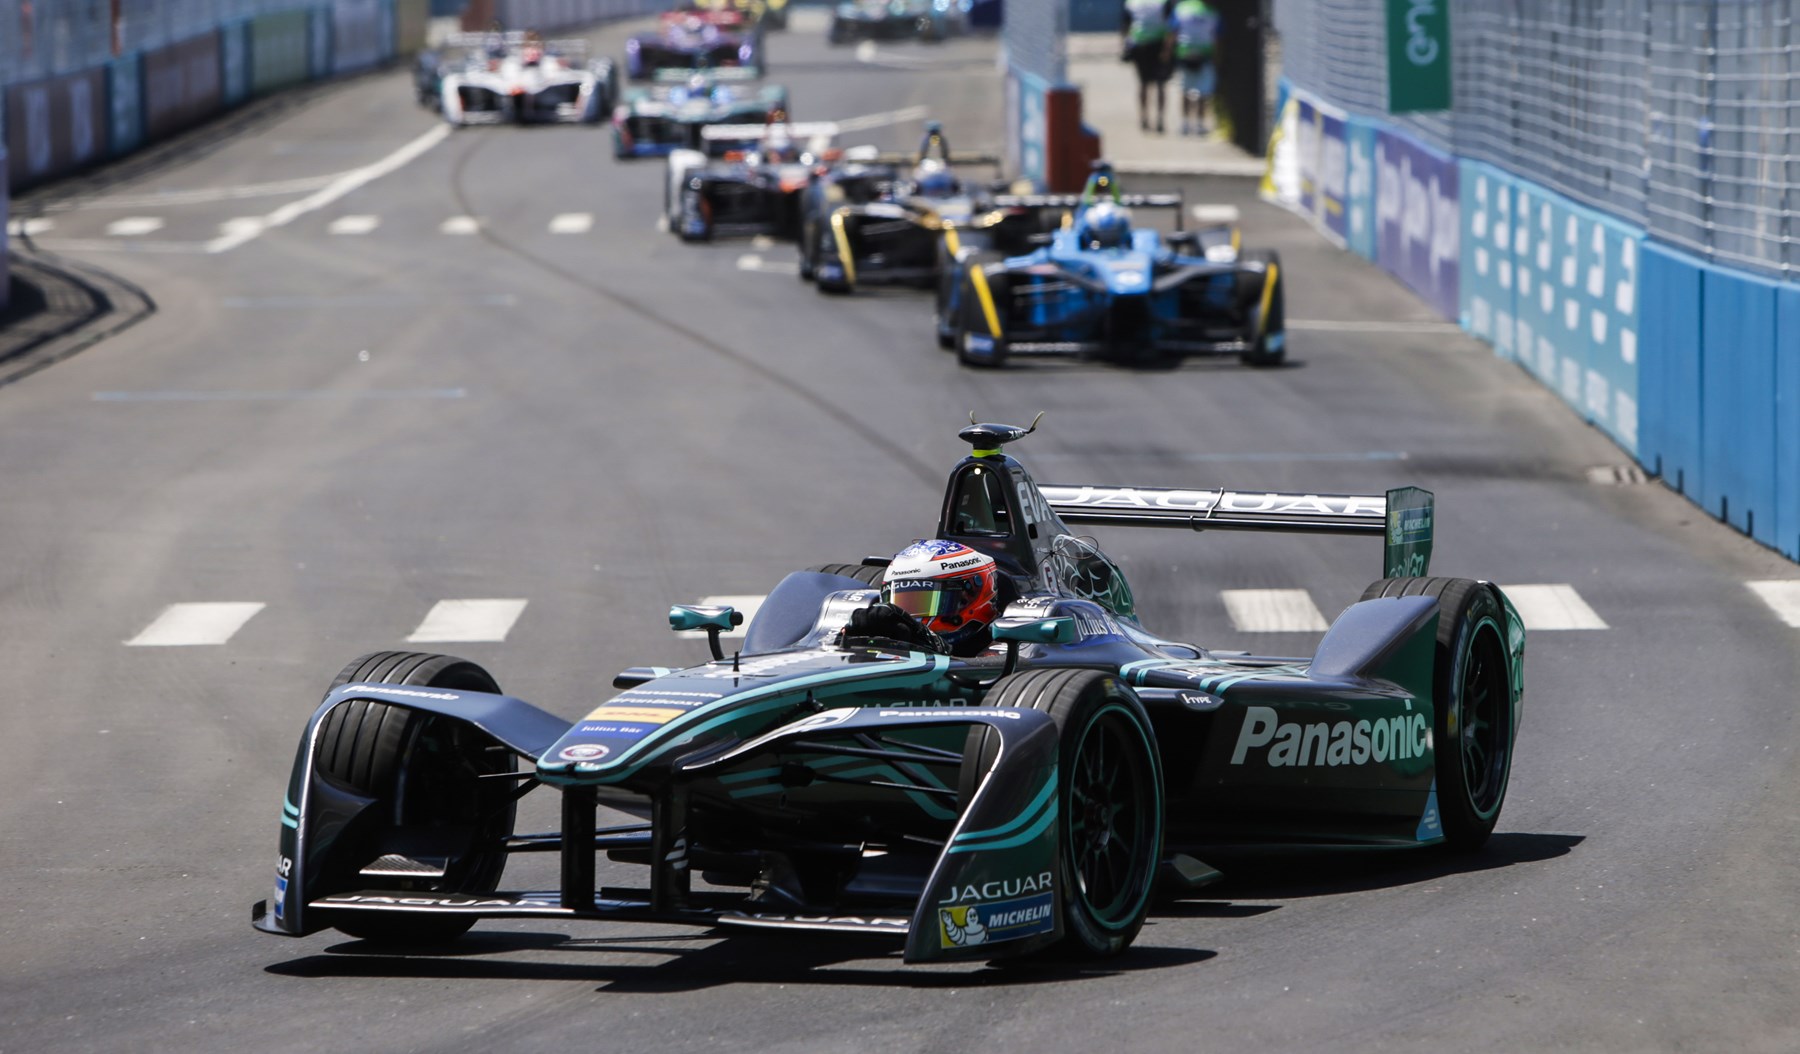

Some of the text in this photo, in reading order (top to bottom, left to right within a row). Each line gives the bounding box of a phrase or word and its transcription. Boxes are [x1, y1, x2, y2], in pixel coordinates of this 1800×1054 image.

[1045, 487, 1386, 515] JAGUAR
[891, 567, 921, 576] Panasonic
[940, 556, 982, 570] Panasonic
[1072, 613, 1109, 642] Julius
[341, 685, 460, 701] Panasonic
[879, 710, 1021, 720] Panasonic
[1230, 698, 1426, 768] Panasonic
[938, 871, 1052, 904] JAGUAR
[326, 895, 550, 907] JAGUAR
[988, 903, 1052, 928] MICHELIN
